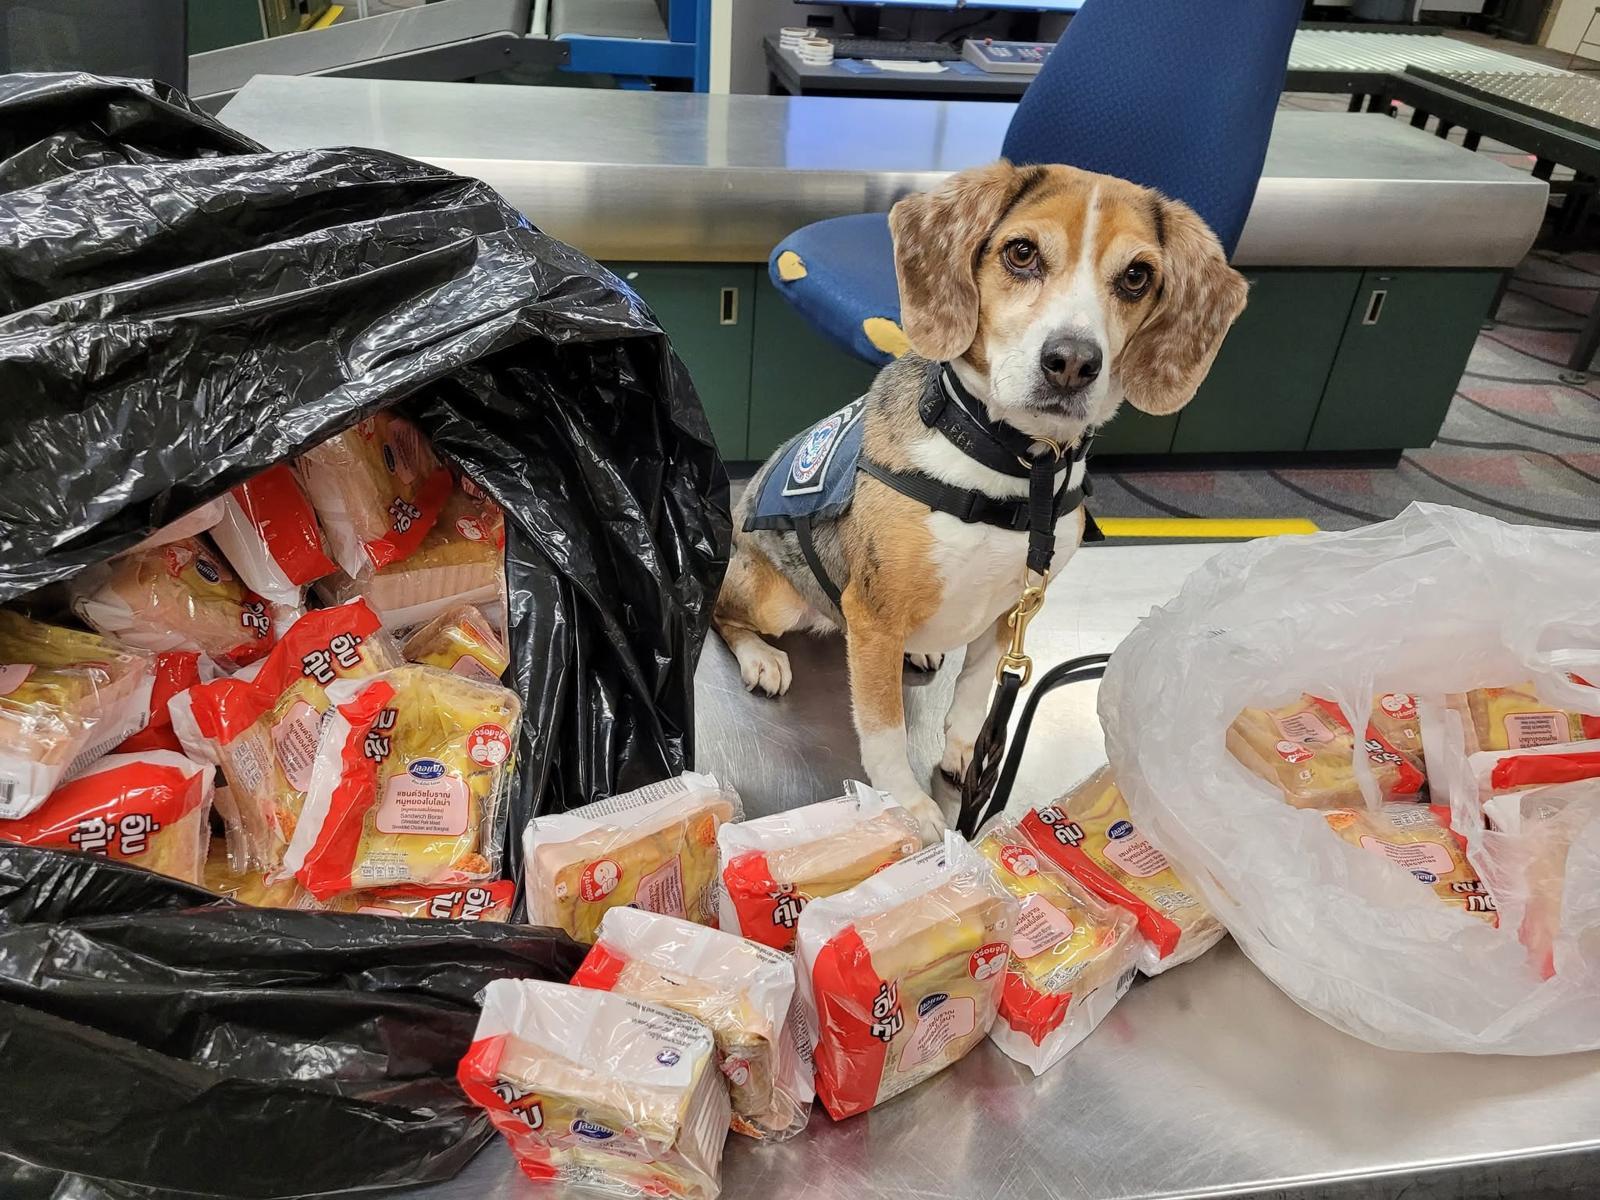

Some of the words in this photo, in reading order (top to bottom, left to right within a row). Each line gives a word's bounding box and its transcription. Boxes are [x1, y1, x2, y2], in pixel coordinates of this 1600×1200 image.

[302, 650, 336, 684] คุ้ม
[330, 632, 362, 668] อิ่ม
[364, 732, 391, 762] คุ้ม
[120, 814, 160, 854] อิ่ม
[1053, 823, 1084, 847] คุ้ม
[872, 983, 899, 1018] อิ่ม
